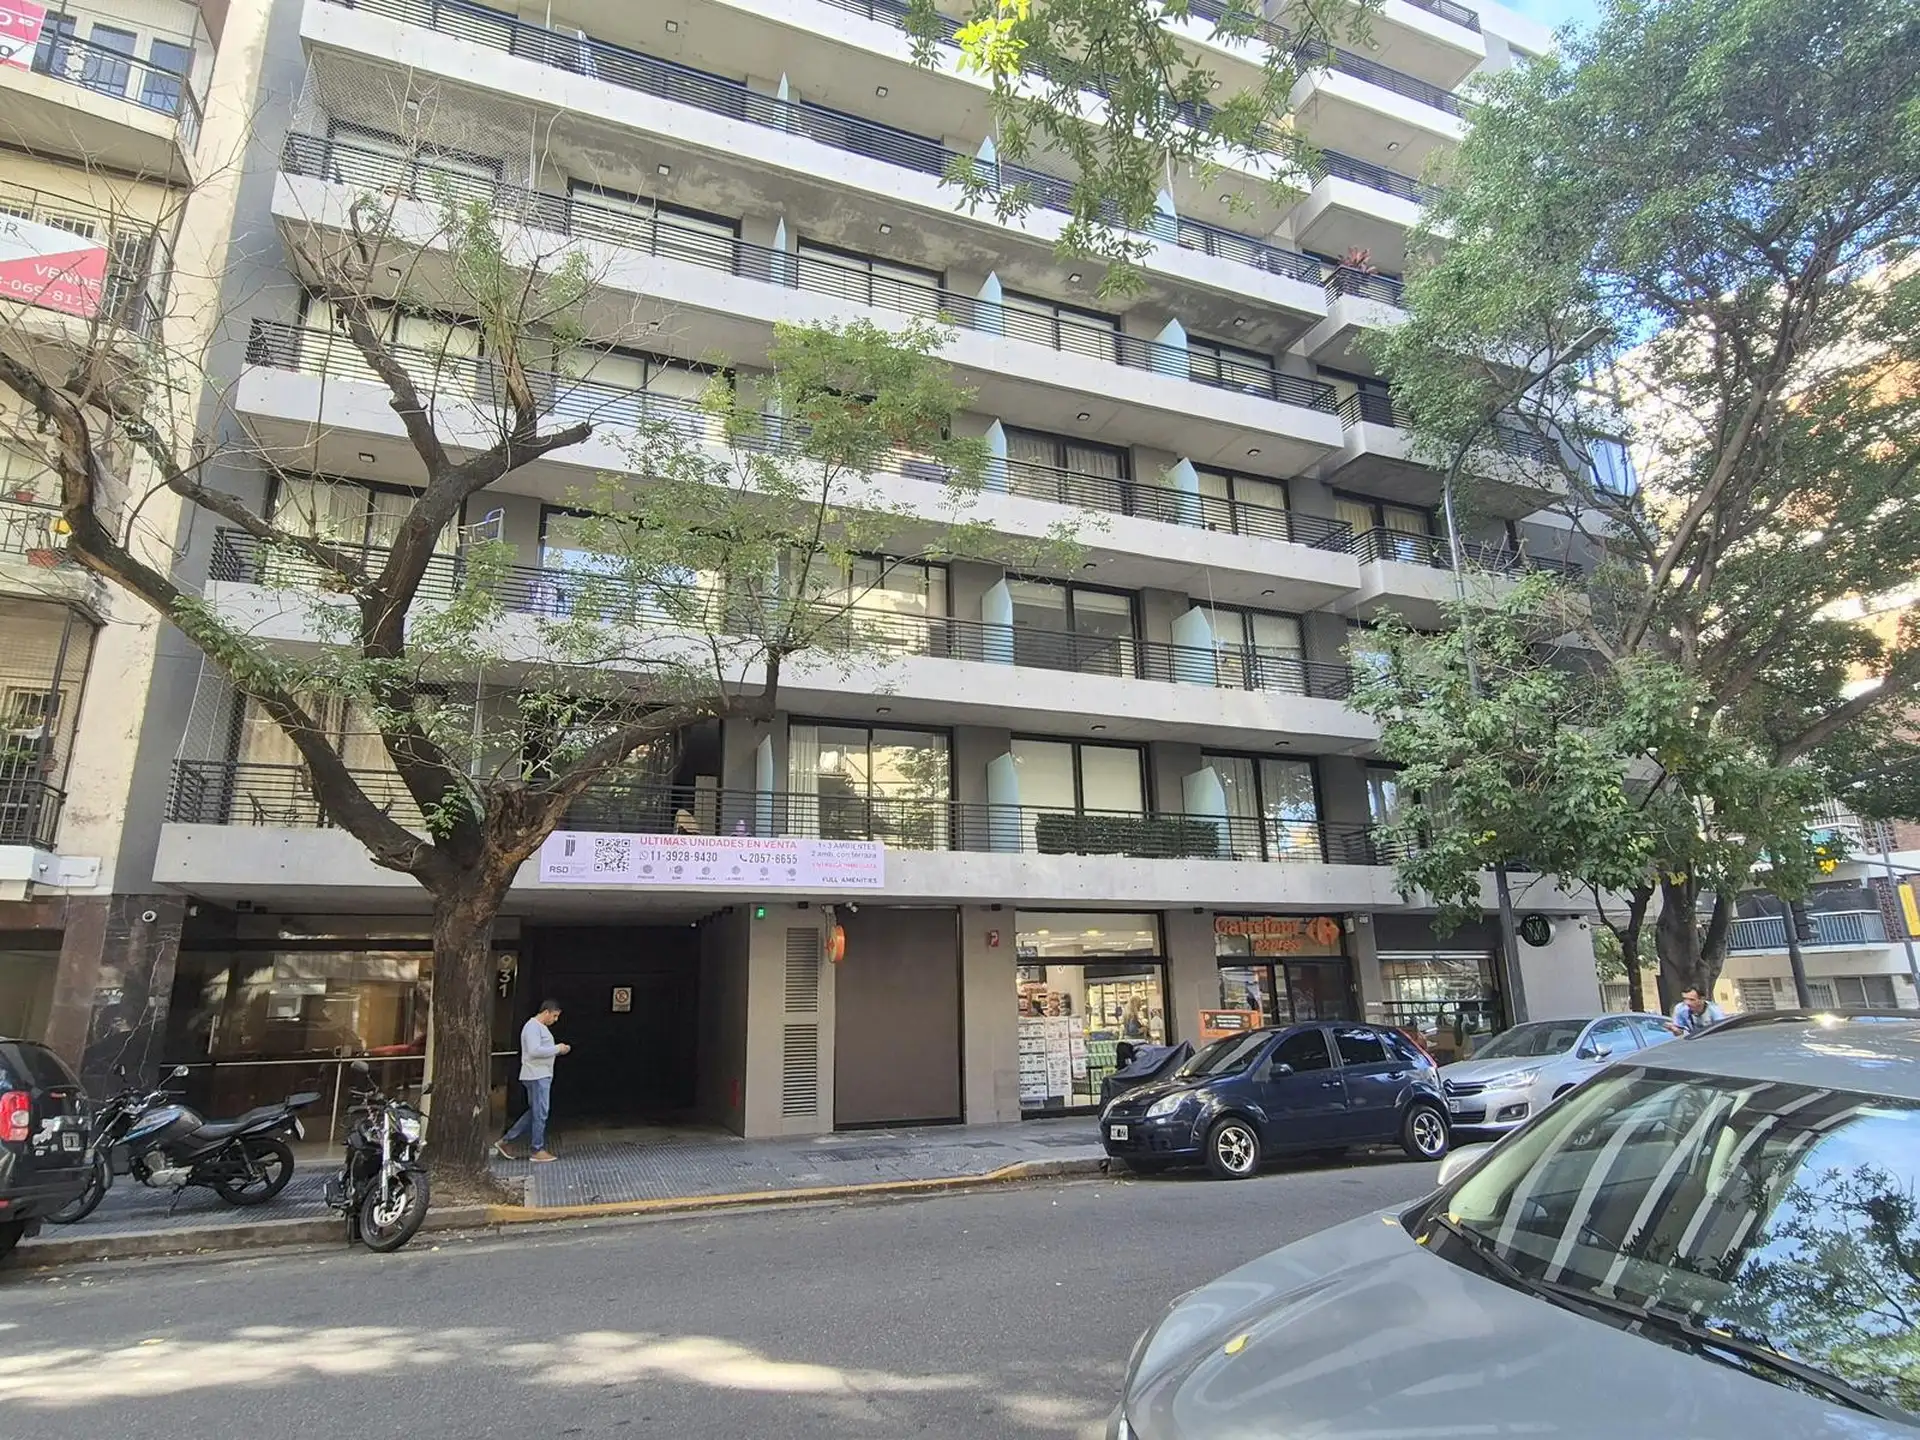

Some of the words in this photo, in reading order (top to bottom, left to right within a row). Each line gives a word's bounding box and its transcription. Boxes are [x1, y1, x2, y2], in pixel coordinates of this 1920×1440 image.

[689, 838, 744, 848] UNIDADES
[747, 840, 760, 849] EN
[763, 841, 797, 849] VENTA
[549, 866, 569, 874] RSD
[1214, 916, 1300, 935] Carrefour
